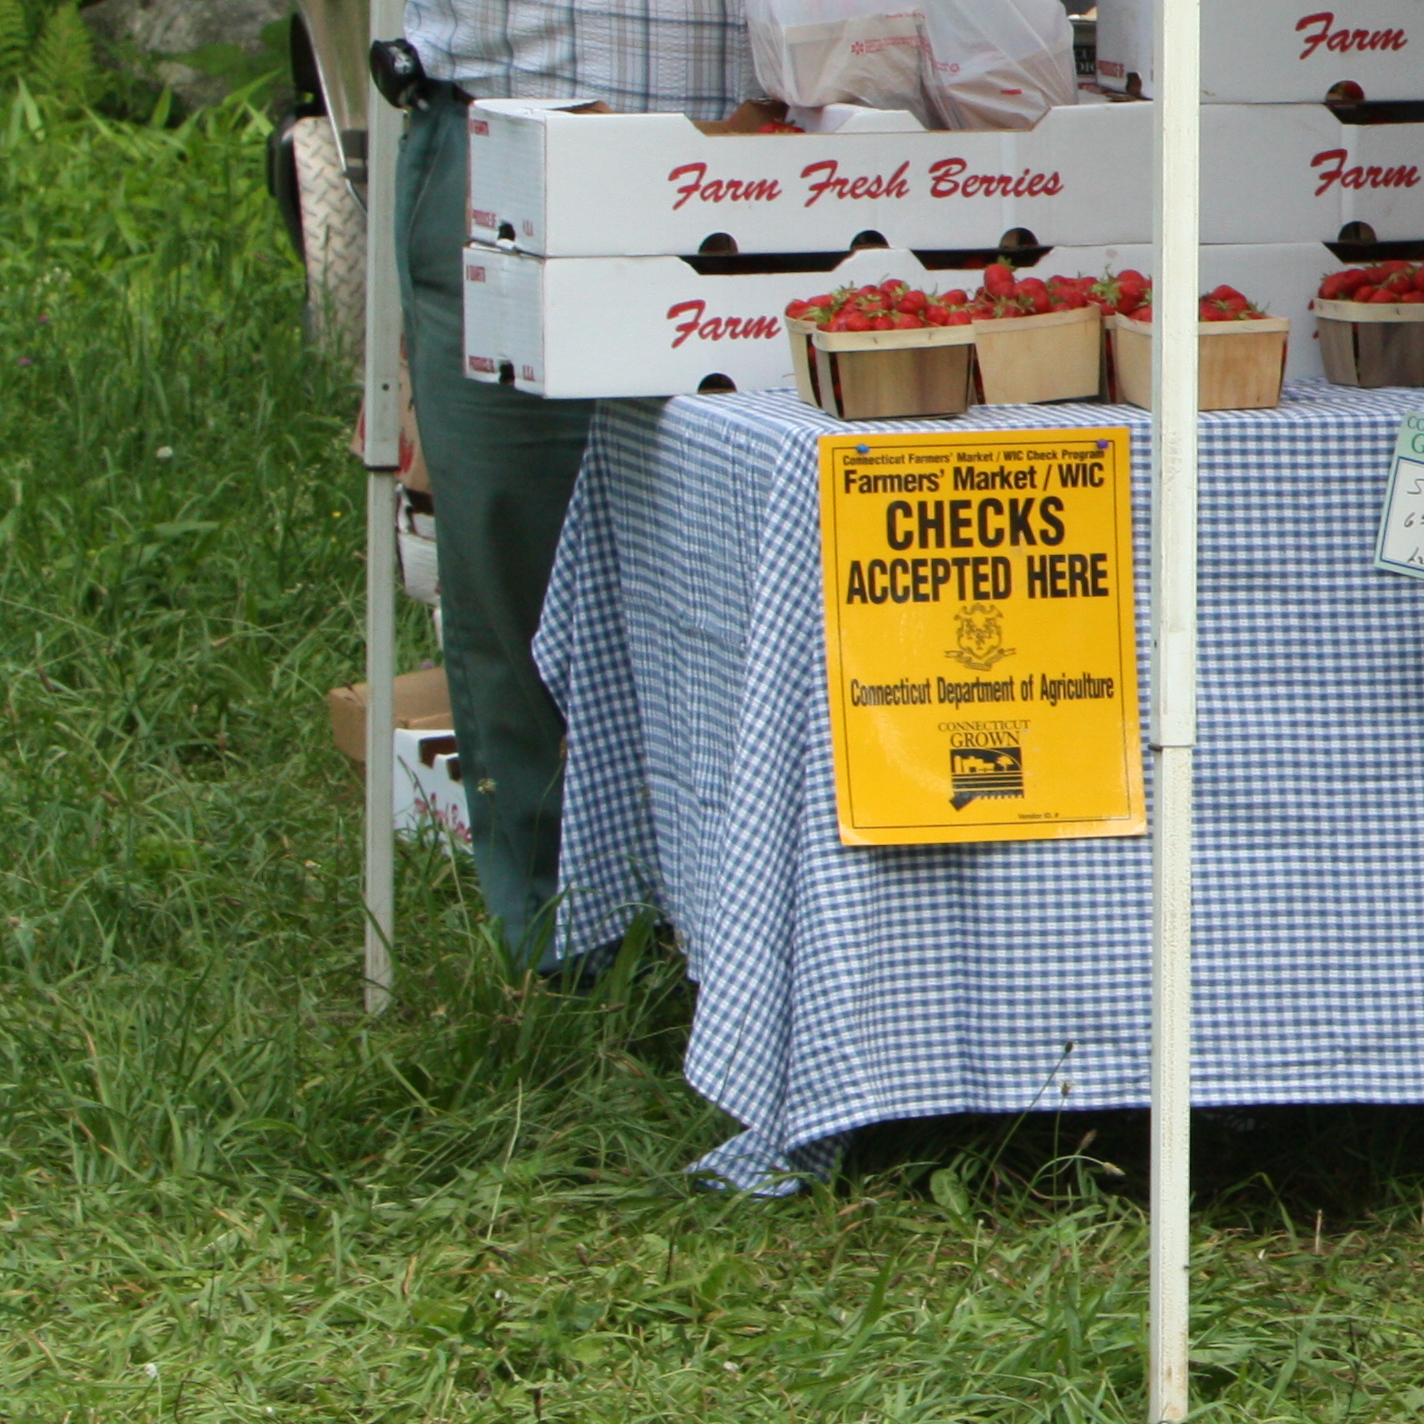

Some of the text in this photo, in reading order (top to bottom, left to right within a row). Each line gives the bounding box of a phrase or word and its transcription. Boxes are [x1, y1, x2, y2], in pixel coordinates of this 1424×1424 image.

[1295, 11, 1408, 60] Farm
[668, 157, 1064, 211] Farm Fresh Berries
[1310, 148, 1421, 197] Farm
[666, 299, 784, 349] Farm
[843, 454, 906, 466] Connecticut
[957, 451, 994, 463] Market
[1003, 450, 1024, 461] WIC
[1026, 449, 1057, 461] Check
[1061, 448, 1105, 462] Program
[844, 468, 945, 495] Farmers'
[953, 465, 1037, 491] Market
[1057, 462, 1105, 488] WIC
[886, 495, 1066, 551] CHECKS
[846, 553, 1110, 605] ACCEPTED HERE
[851, 672, 1115, 710] Connecticut Department of Agriculture
[937, 719, 1031, 733] CONNECTICUT
[950, 730, 1021, 749] GROWN
